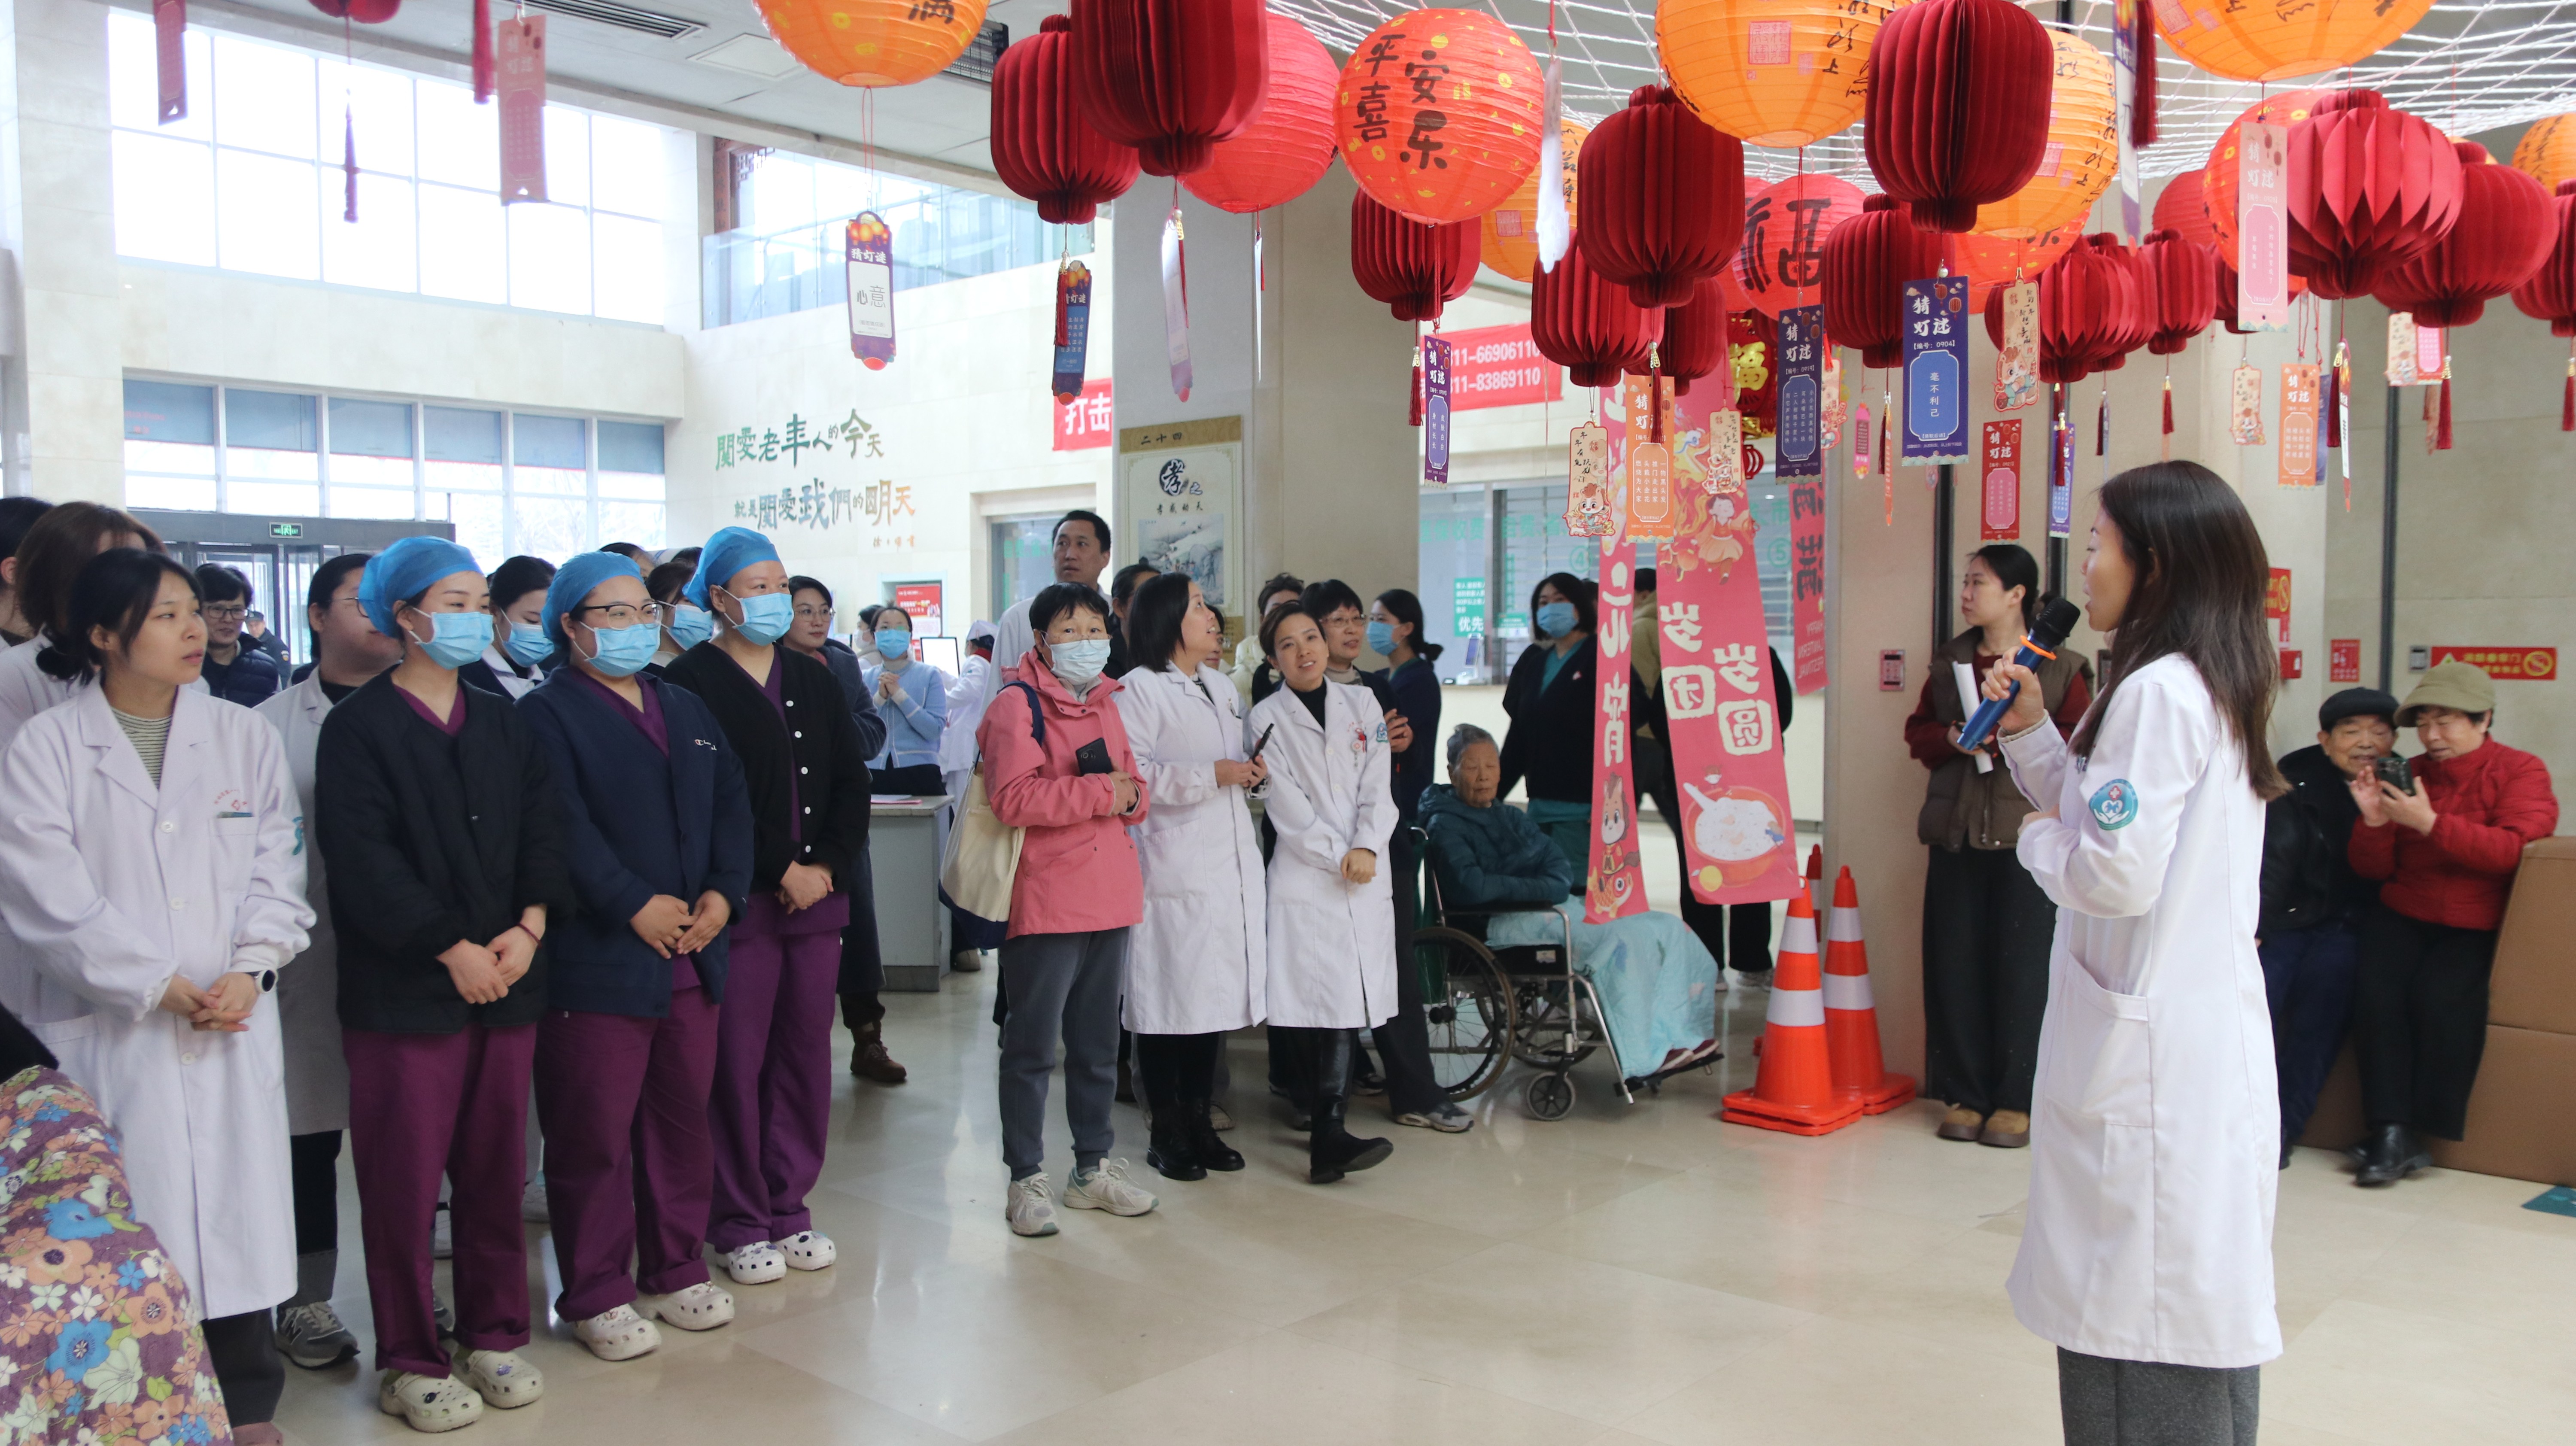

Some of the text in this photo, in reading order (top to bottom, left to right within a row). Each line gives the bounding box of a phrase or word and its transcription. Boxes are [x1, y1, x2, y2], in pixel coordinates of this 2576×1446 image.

[2248, 142, 2260, 163] 猜
[1740, 197, 1831, 294] 福
[851, 248, 887, 264] 猜灯谜
[857, 285, 886, 308] 心意
[1912, 295, 1930, 316] 猜
[1786, 323, 1798, 342] 猜
[1913, 317, 1951, 337] 灯谜
[1429, 350, 1437, 366] 猜
[1786, 344, 1813, 362] 灯谜
[1430, 370, 1446, 385] 灯谜
[1635, 394, 1648, 410] 猜
[1929, 372, 1940, 418] 毫不利己
[1065, 392, 1112, 435] 打击
[1141, 432, 1183, 445] 二十四
[1990, 431, 2000, 444] 猜
[1990, 446, 2012, 459] 灯谜
[1458, 616, 1484, 632] 优先
